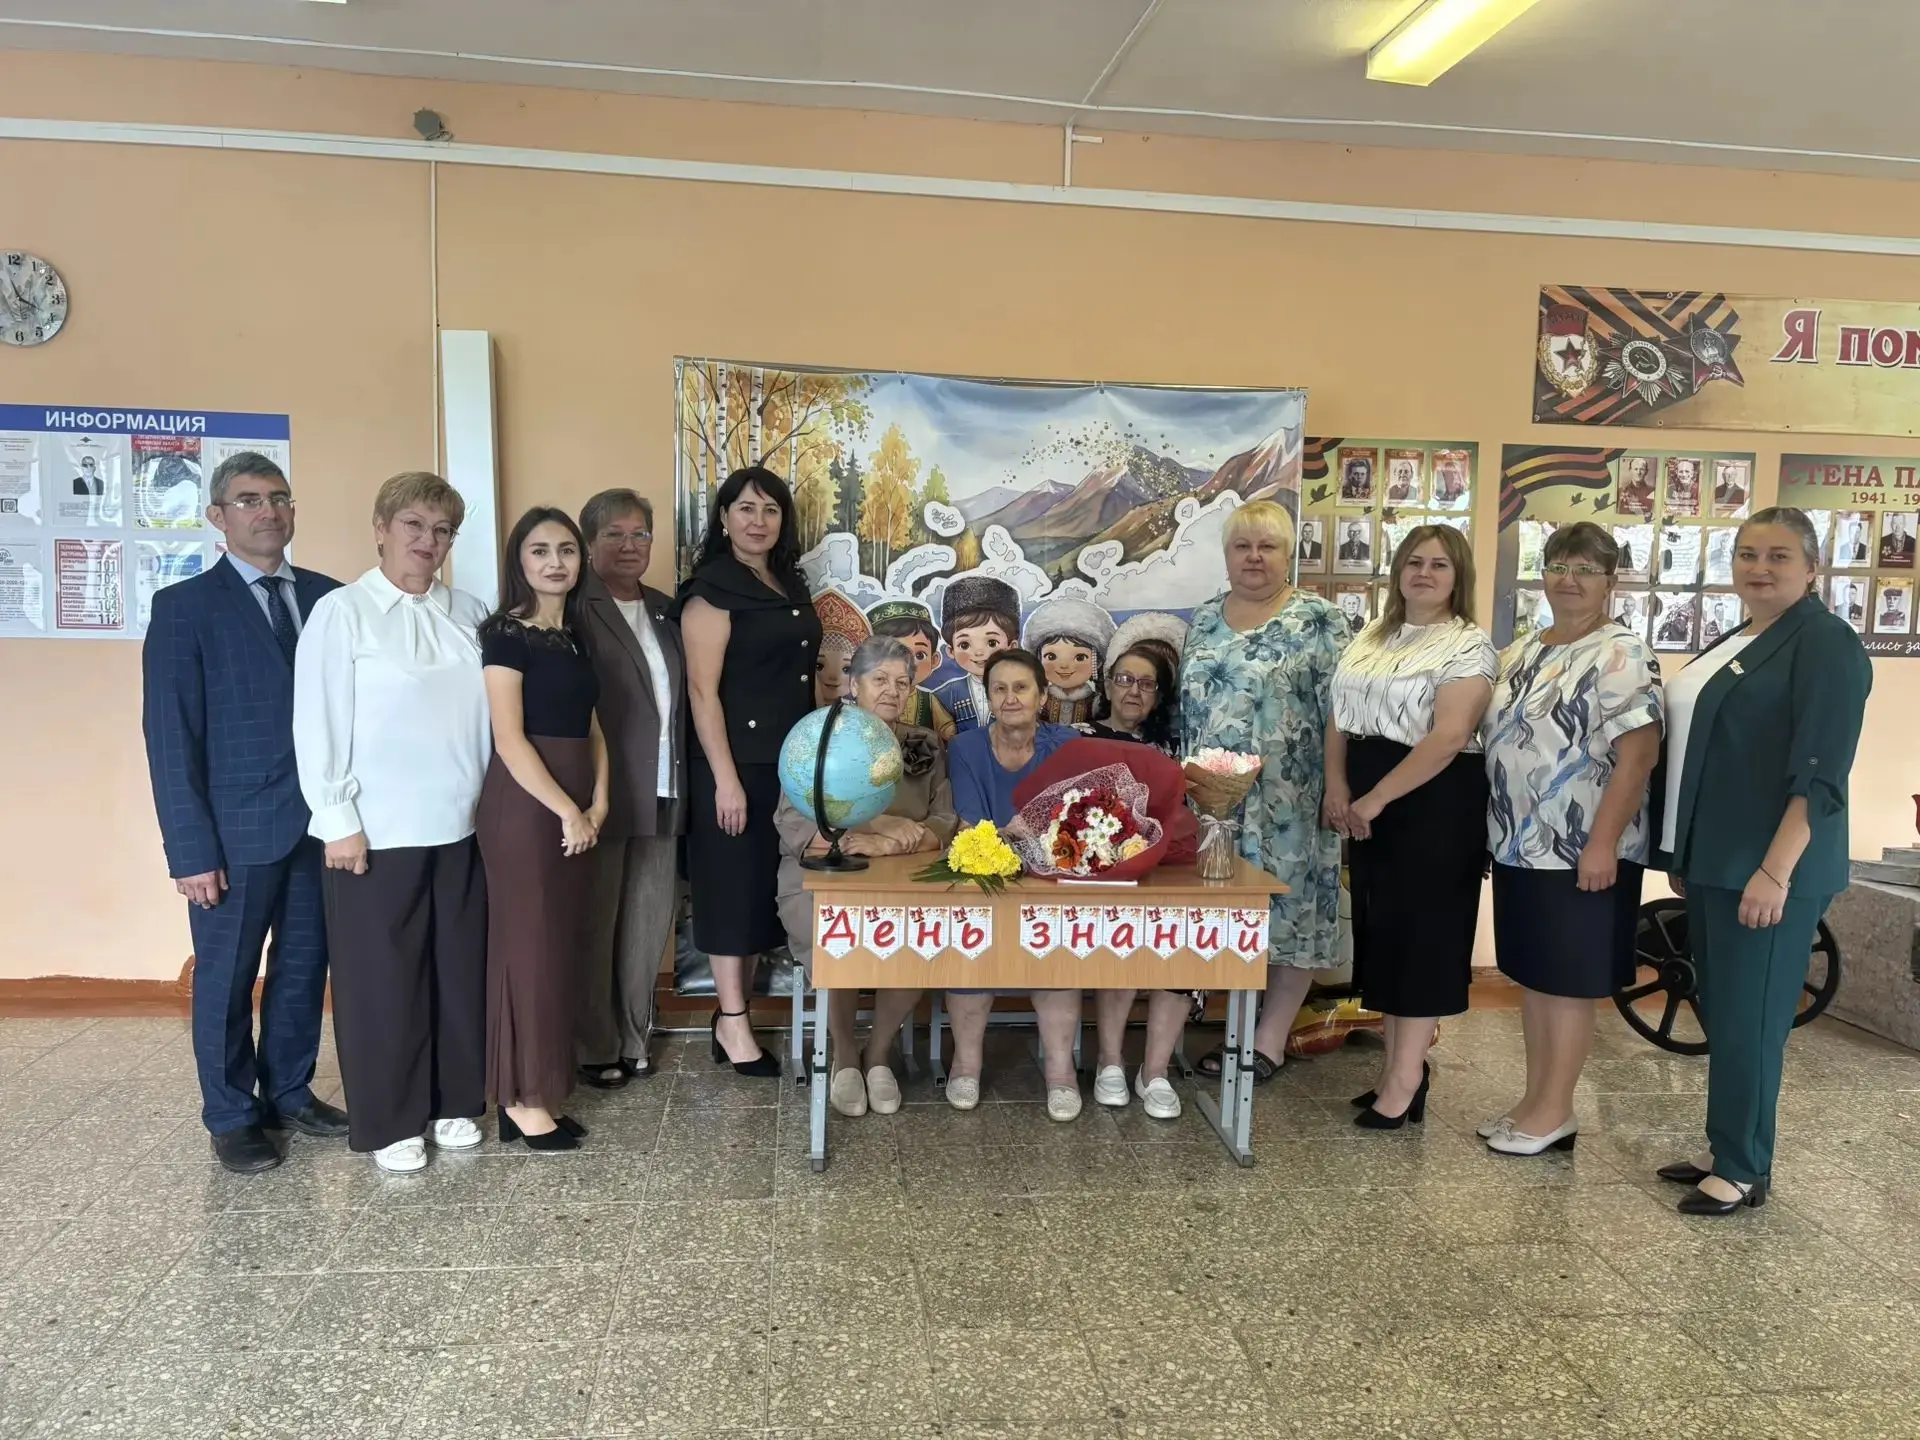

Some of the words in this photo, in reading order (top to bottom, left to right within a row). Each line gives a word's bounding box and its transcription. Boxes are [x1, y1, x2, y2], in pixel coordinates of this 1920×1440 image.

[8, 255, 21, 266] 12
[32, 261, 37, 271] 1
[45, 275, 53, 285] 2
[52, 294, 60, 305] 3
[49, 313, 56, 323] 4
[15, 331, 24, 342] 6
[36, 326, 44, 338] 5
[1769, 308, 1822, 364] Я
[45, 411, 206, 434] ИНФОРМАЦИЯ
[1781, 464, 1884, 488] СТЕНА
[1894, 466, 1920, 488] П
[1851, 492, 1887, 504] 1941
[98, 600, 117, 611] 104
[98, 613, 117, 624] 112
[821, 908, 985, 950] День
[1029, 919, 1260, 953] знаний
